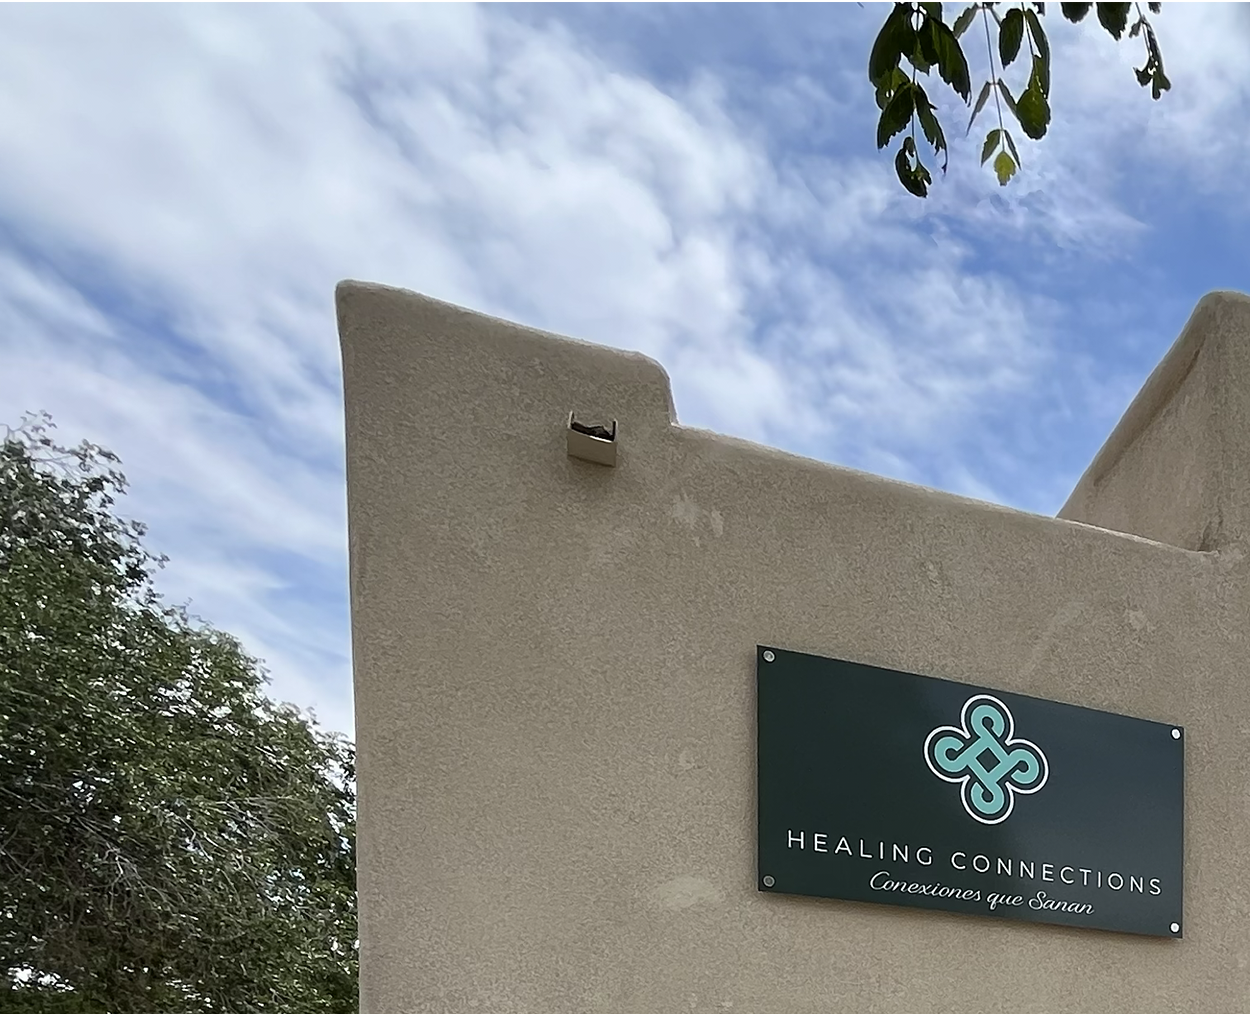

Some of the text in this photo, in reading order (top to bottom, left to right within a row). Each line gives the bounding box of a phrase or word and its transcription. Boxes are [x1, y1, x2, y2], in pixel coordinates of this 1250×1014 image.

[787, 830, 1162, 896] HEALING CONNECTIONS
[869, 870, 1095, 915] Conexiones que Sanan
